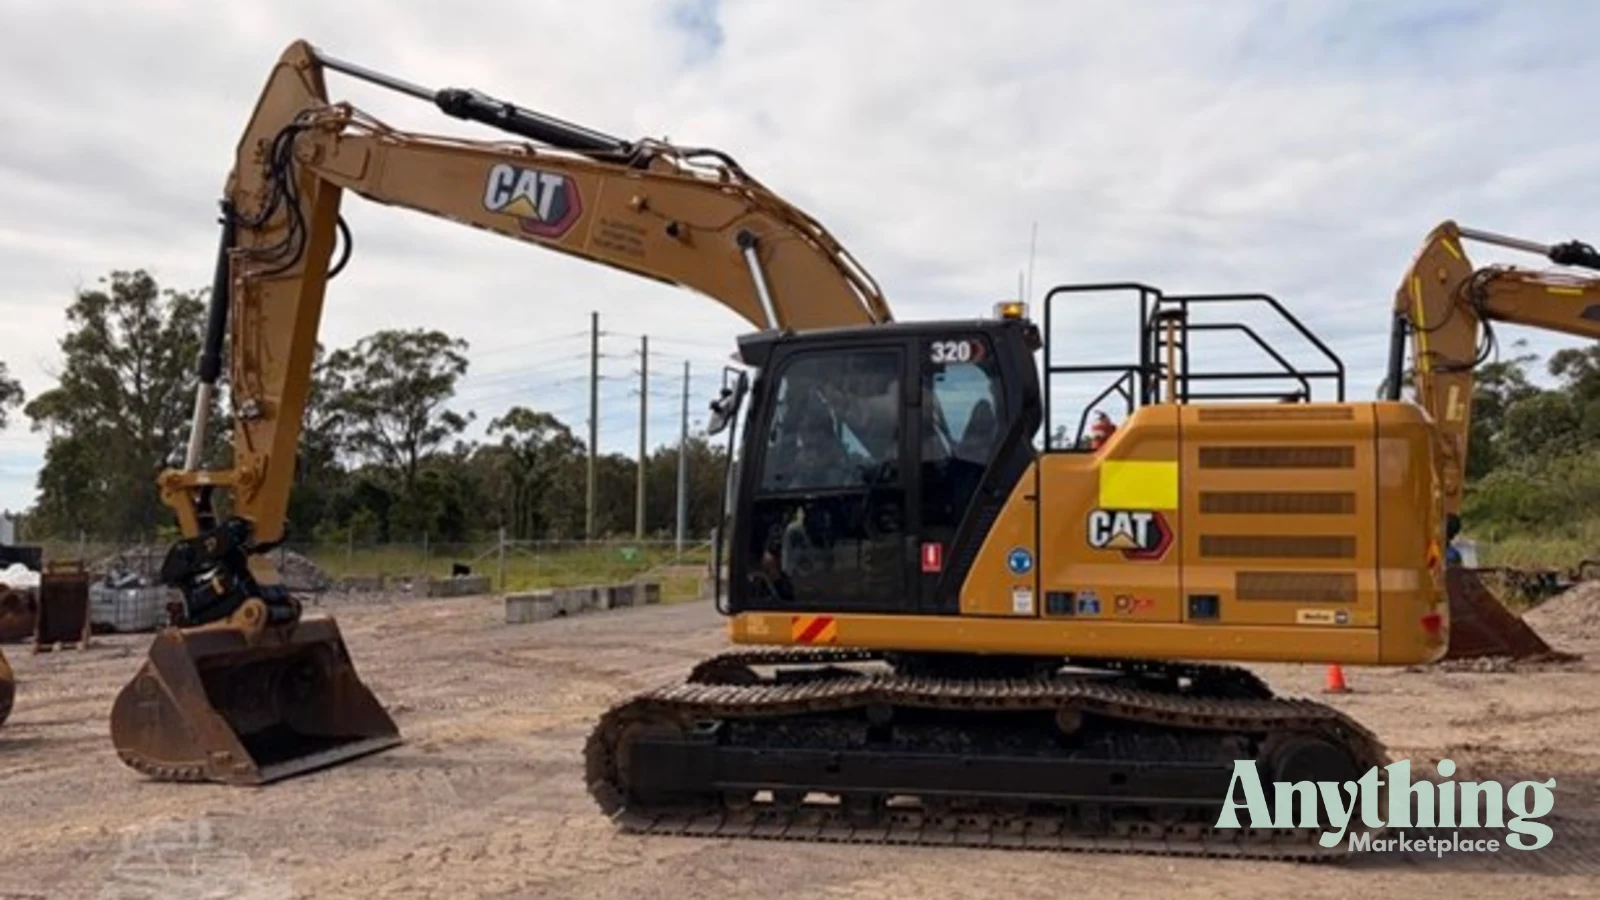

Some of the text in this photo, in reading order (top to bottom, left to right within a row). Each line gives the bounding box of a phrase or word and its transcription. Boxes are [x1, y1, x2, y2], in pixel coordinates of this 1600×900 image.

[484, 164, 563, 220] CAT
[931, 341, 971, 362] 320
[1088, 510, 1153, 548] CAT
